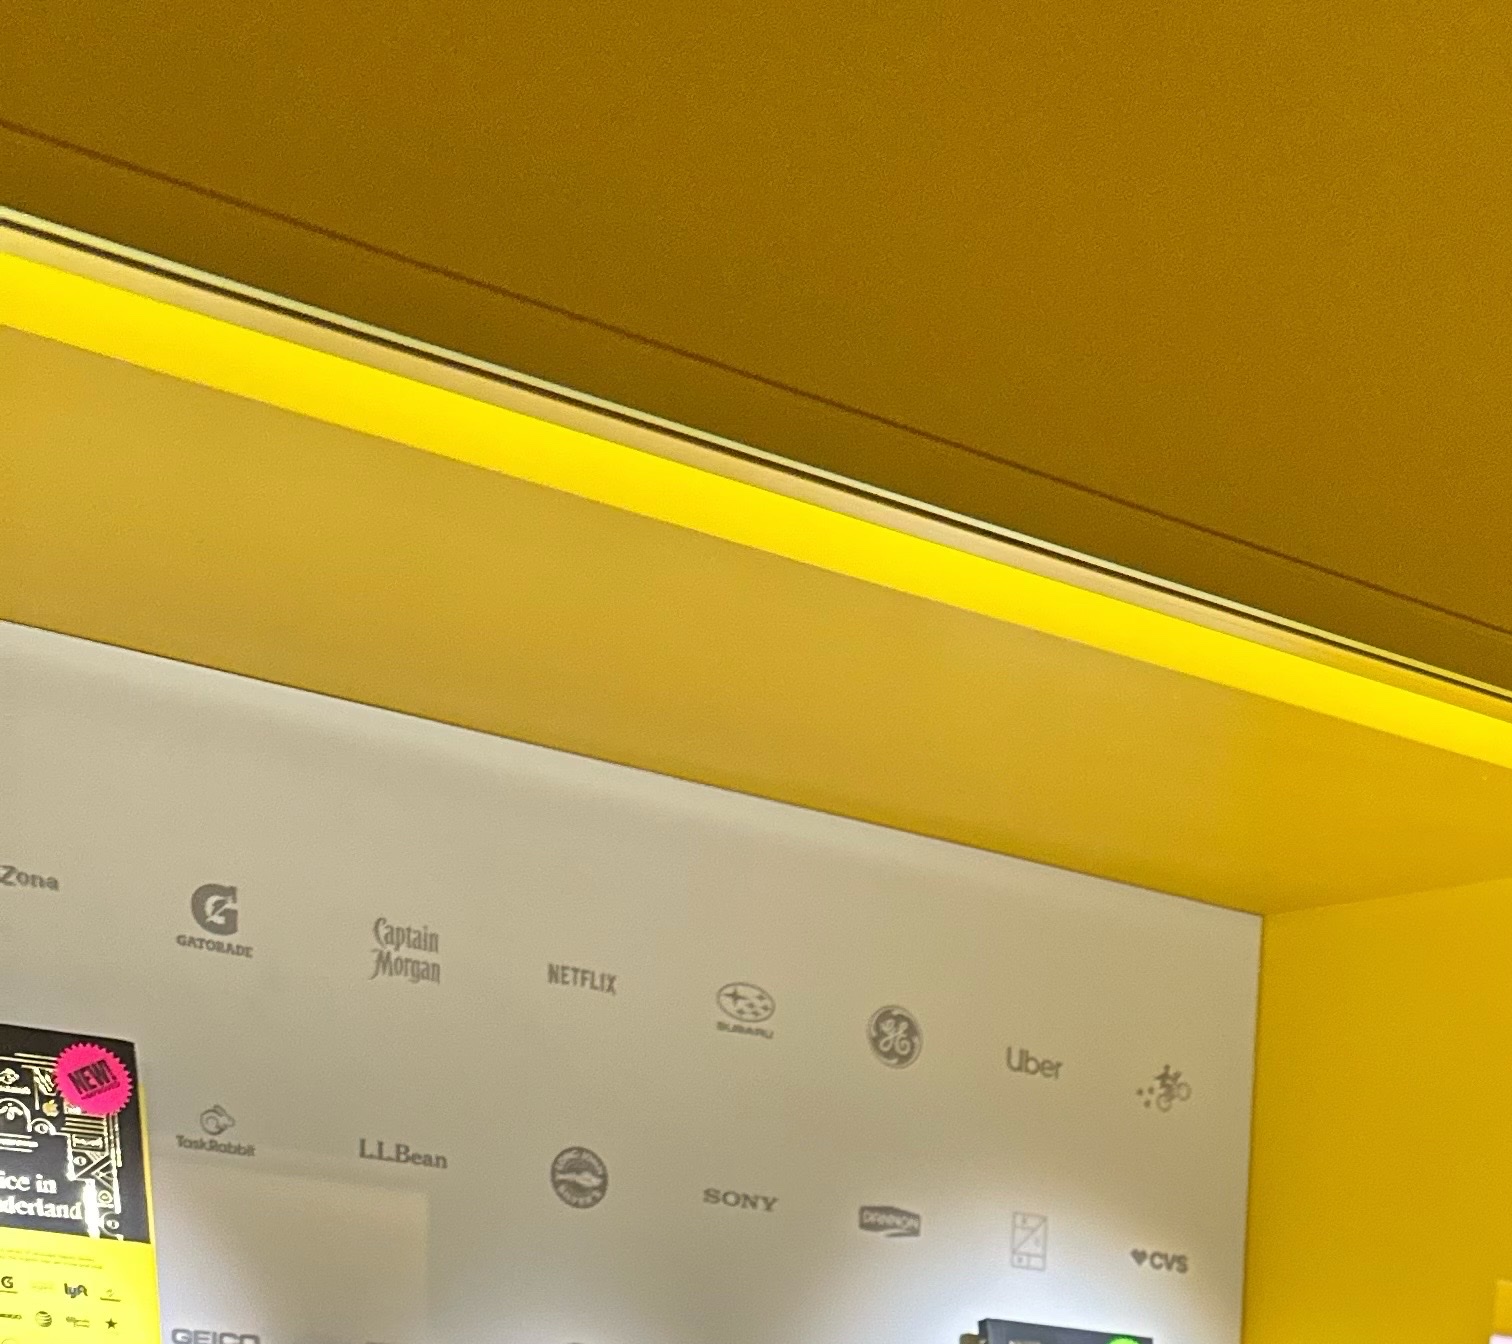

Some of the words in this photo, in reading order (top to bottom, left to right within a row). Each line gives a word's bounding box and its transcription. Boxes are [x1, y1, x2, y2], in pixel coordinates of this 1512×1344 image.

[176, 934, 254, 958] GATORADE
[374, 917, 439, 953] Captain
[368, 948, 441, 984] Morgan
[547, 963, 617, 996] NETFLIX
[1006, 1046, 1064, 1081] Uber
[175, 1134, 256, 1156] TaskRabbit
[35, 1173, 58, 1194] in
[702, 1187, 778, 1213] SONY
[1150, 1251, 1189, 1274] CVS
